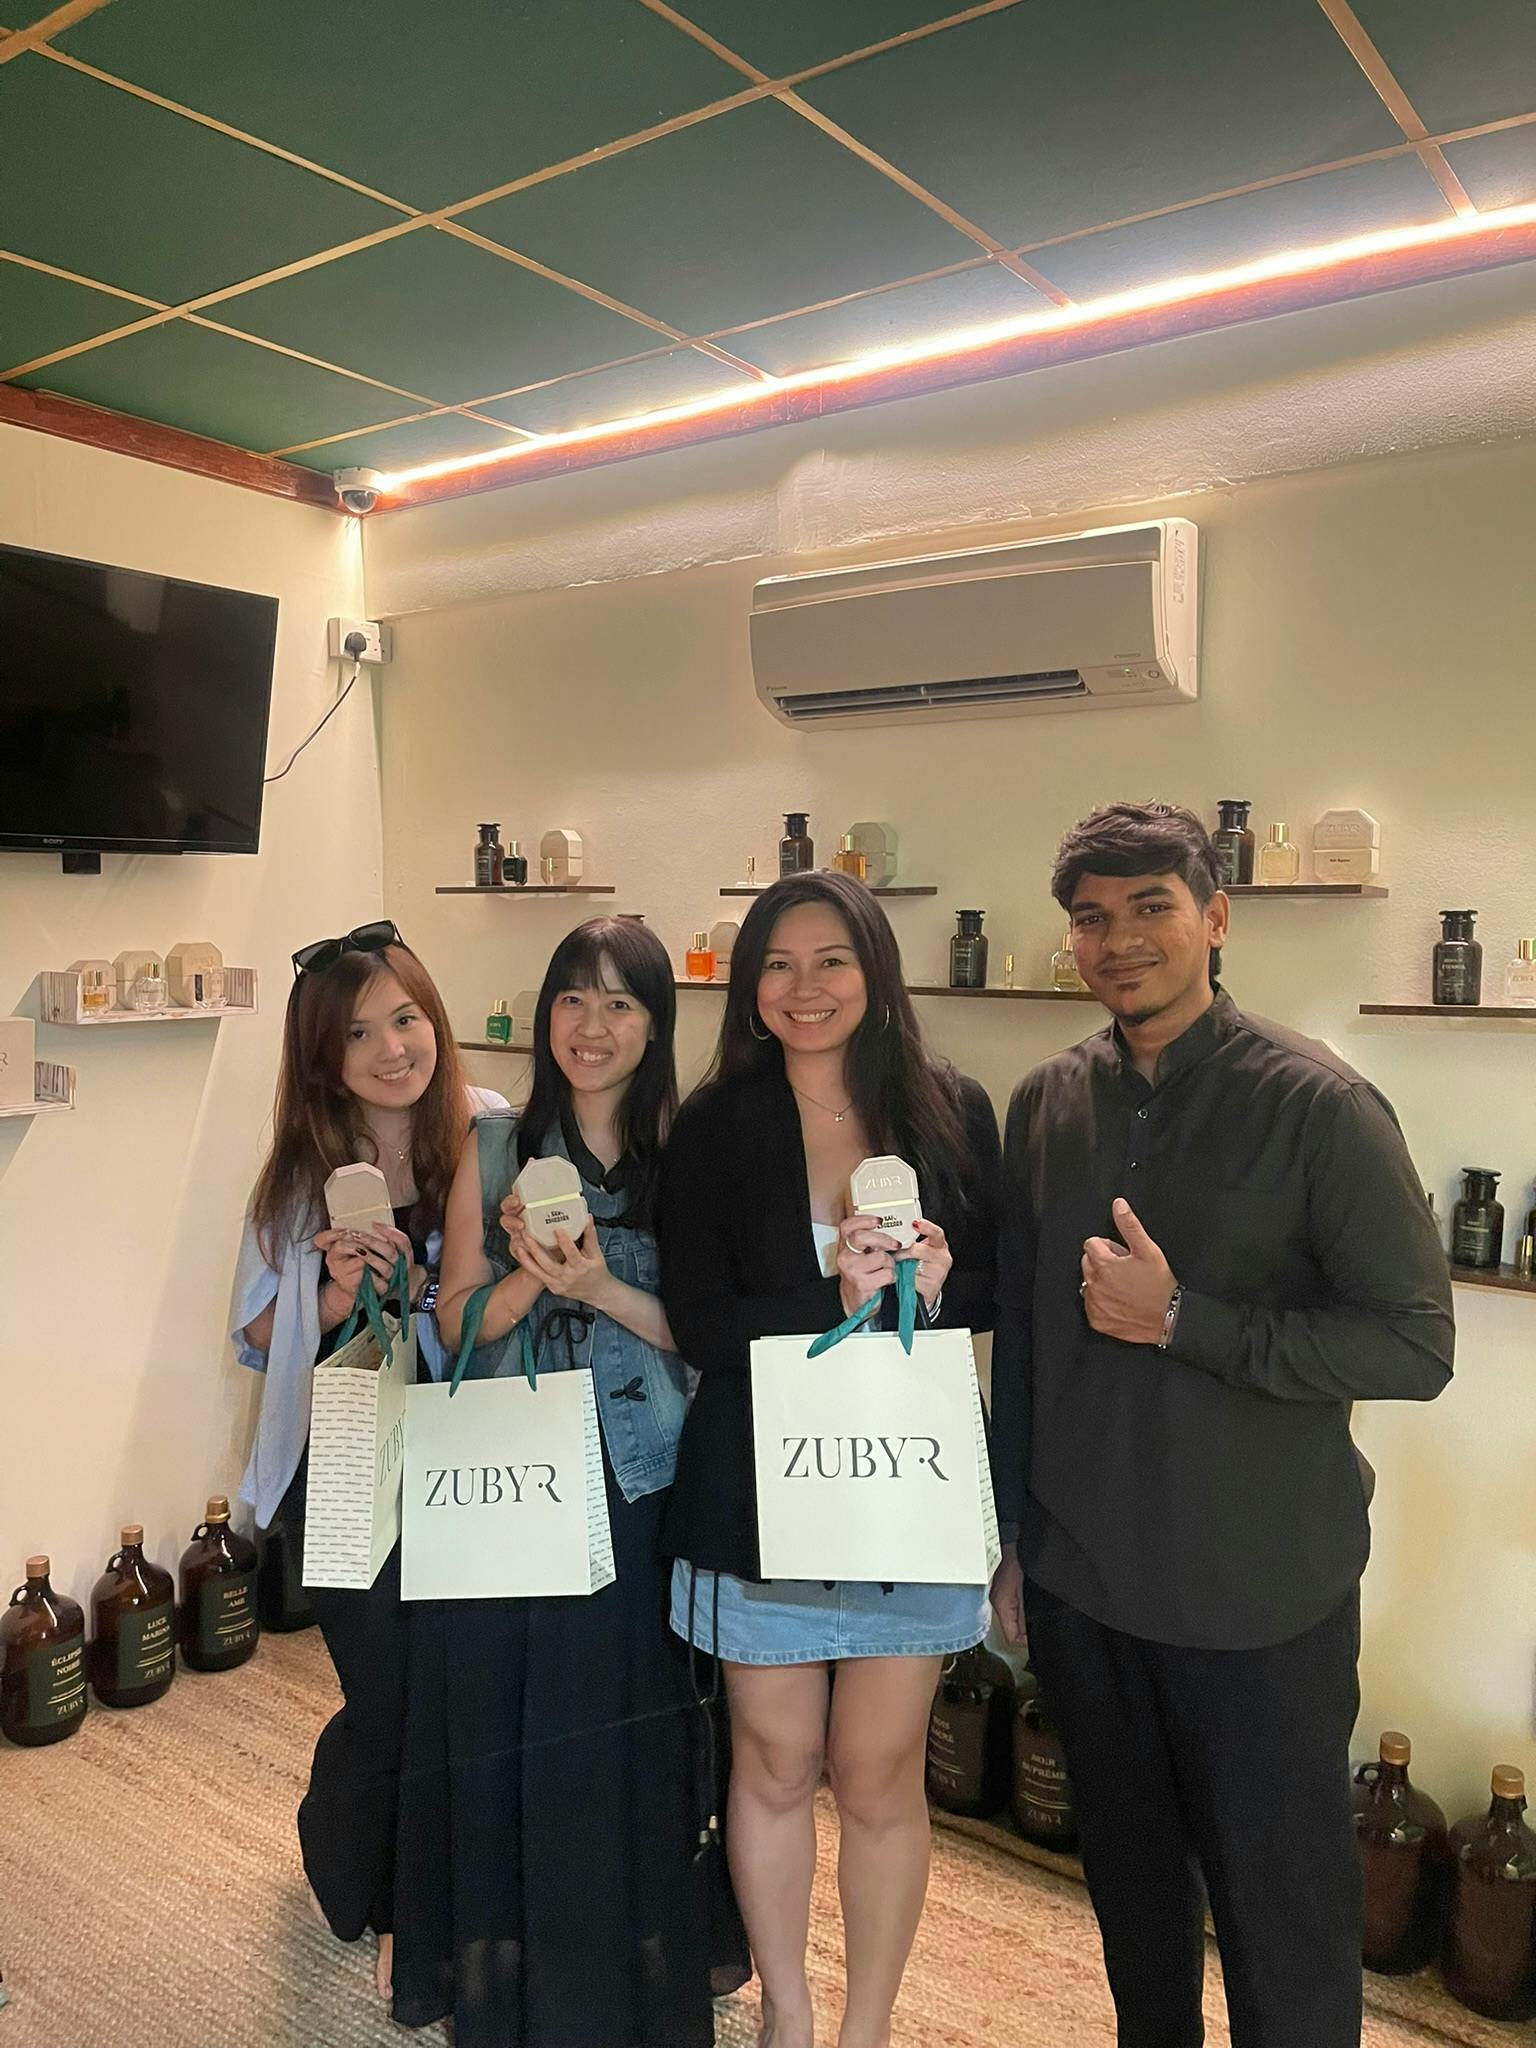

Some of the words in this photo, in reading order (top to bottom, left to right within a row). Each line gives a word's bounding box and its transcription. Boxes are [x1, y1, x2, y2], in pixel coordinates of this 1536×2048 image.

[378, 1409, 406, 1487] ZUBY
[783, 1437, 949, 1481] ZUBYR
[425, 1463, 562, 1507] ZUBYR
